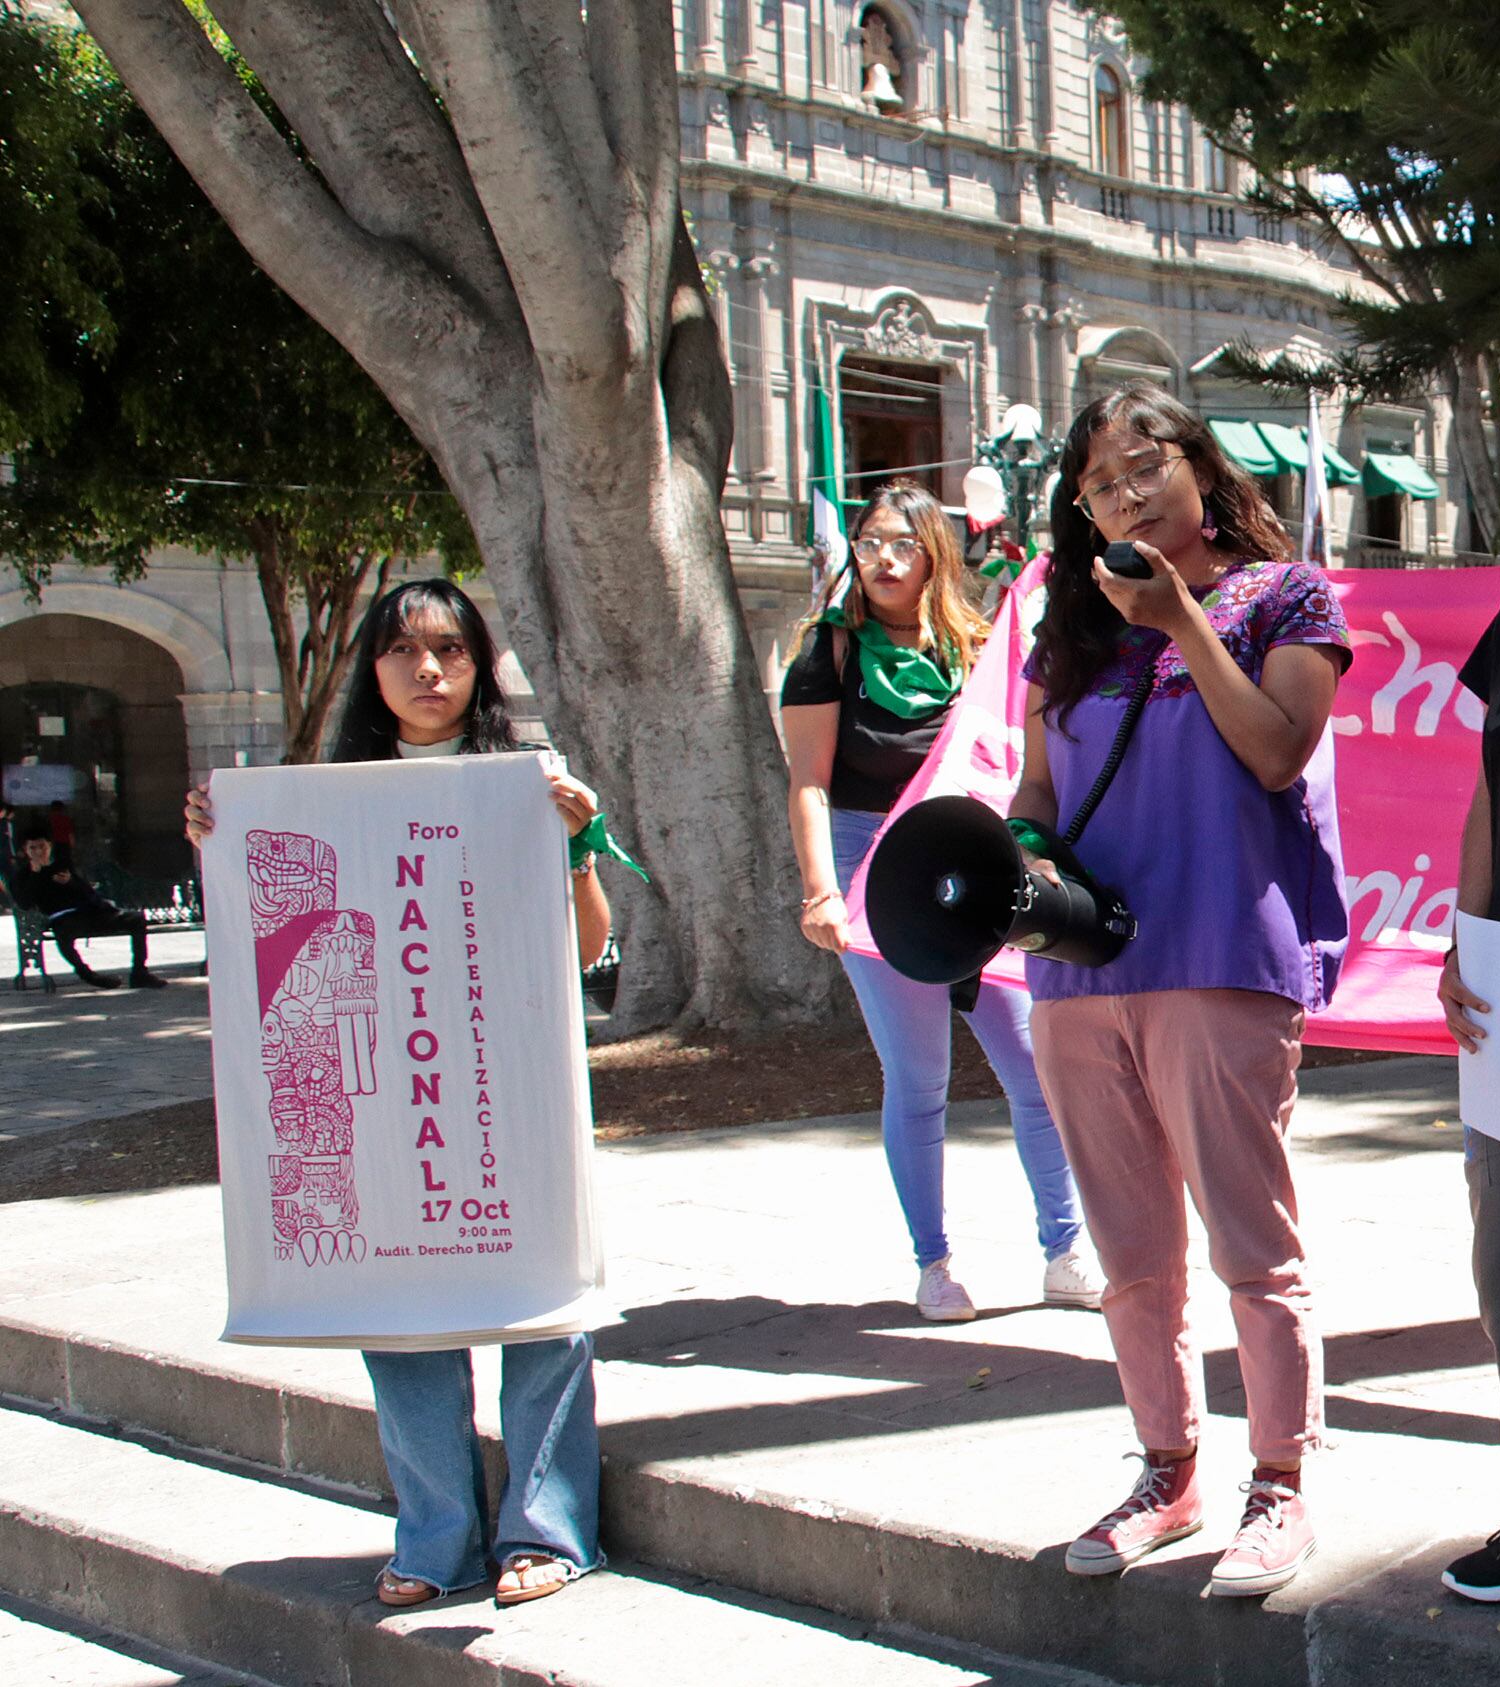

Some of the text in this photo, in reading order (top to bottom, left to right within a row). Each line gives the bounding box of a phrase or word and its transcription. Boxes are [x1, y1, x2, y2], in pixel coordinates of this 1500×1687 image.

[408, 822, 459, 840] Foro
[396, 854, 446, 1191] NACIONAL
[459, 880, 496, 1188] DESPENALIZACIÓN
[421, 1199, 510, 1222] 17 Oct
[458, 1226, 512, 1238] 9:00 am
[418, 1243, 473, 1256] Derecho
[477, 1242, 512, 1254] BUAP
